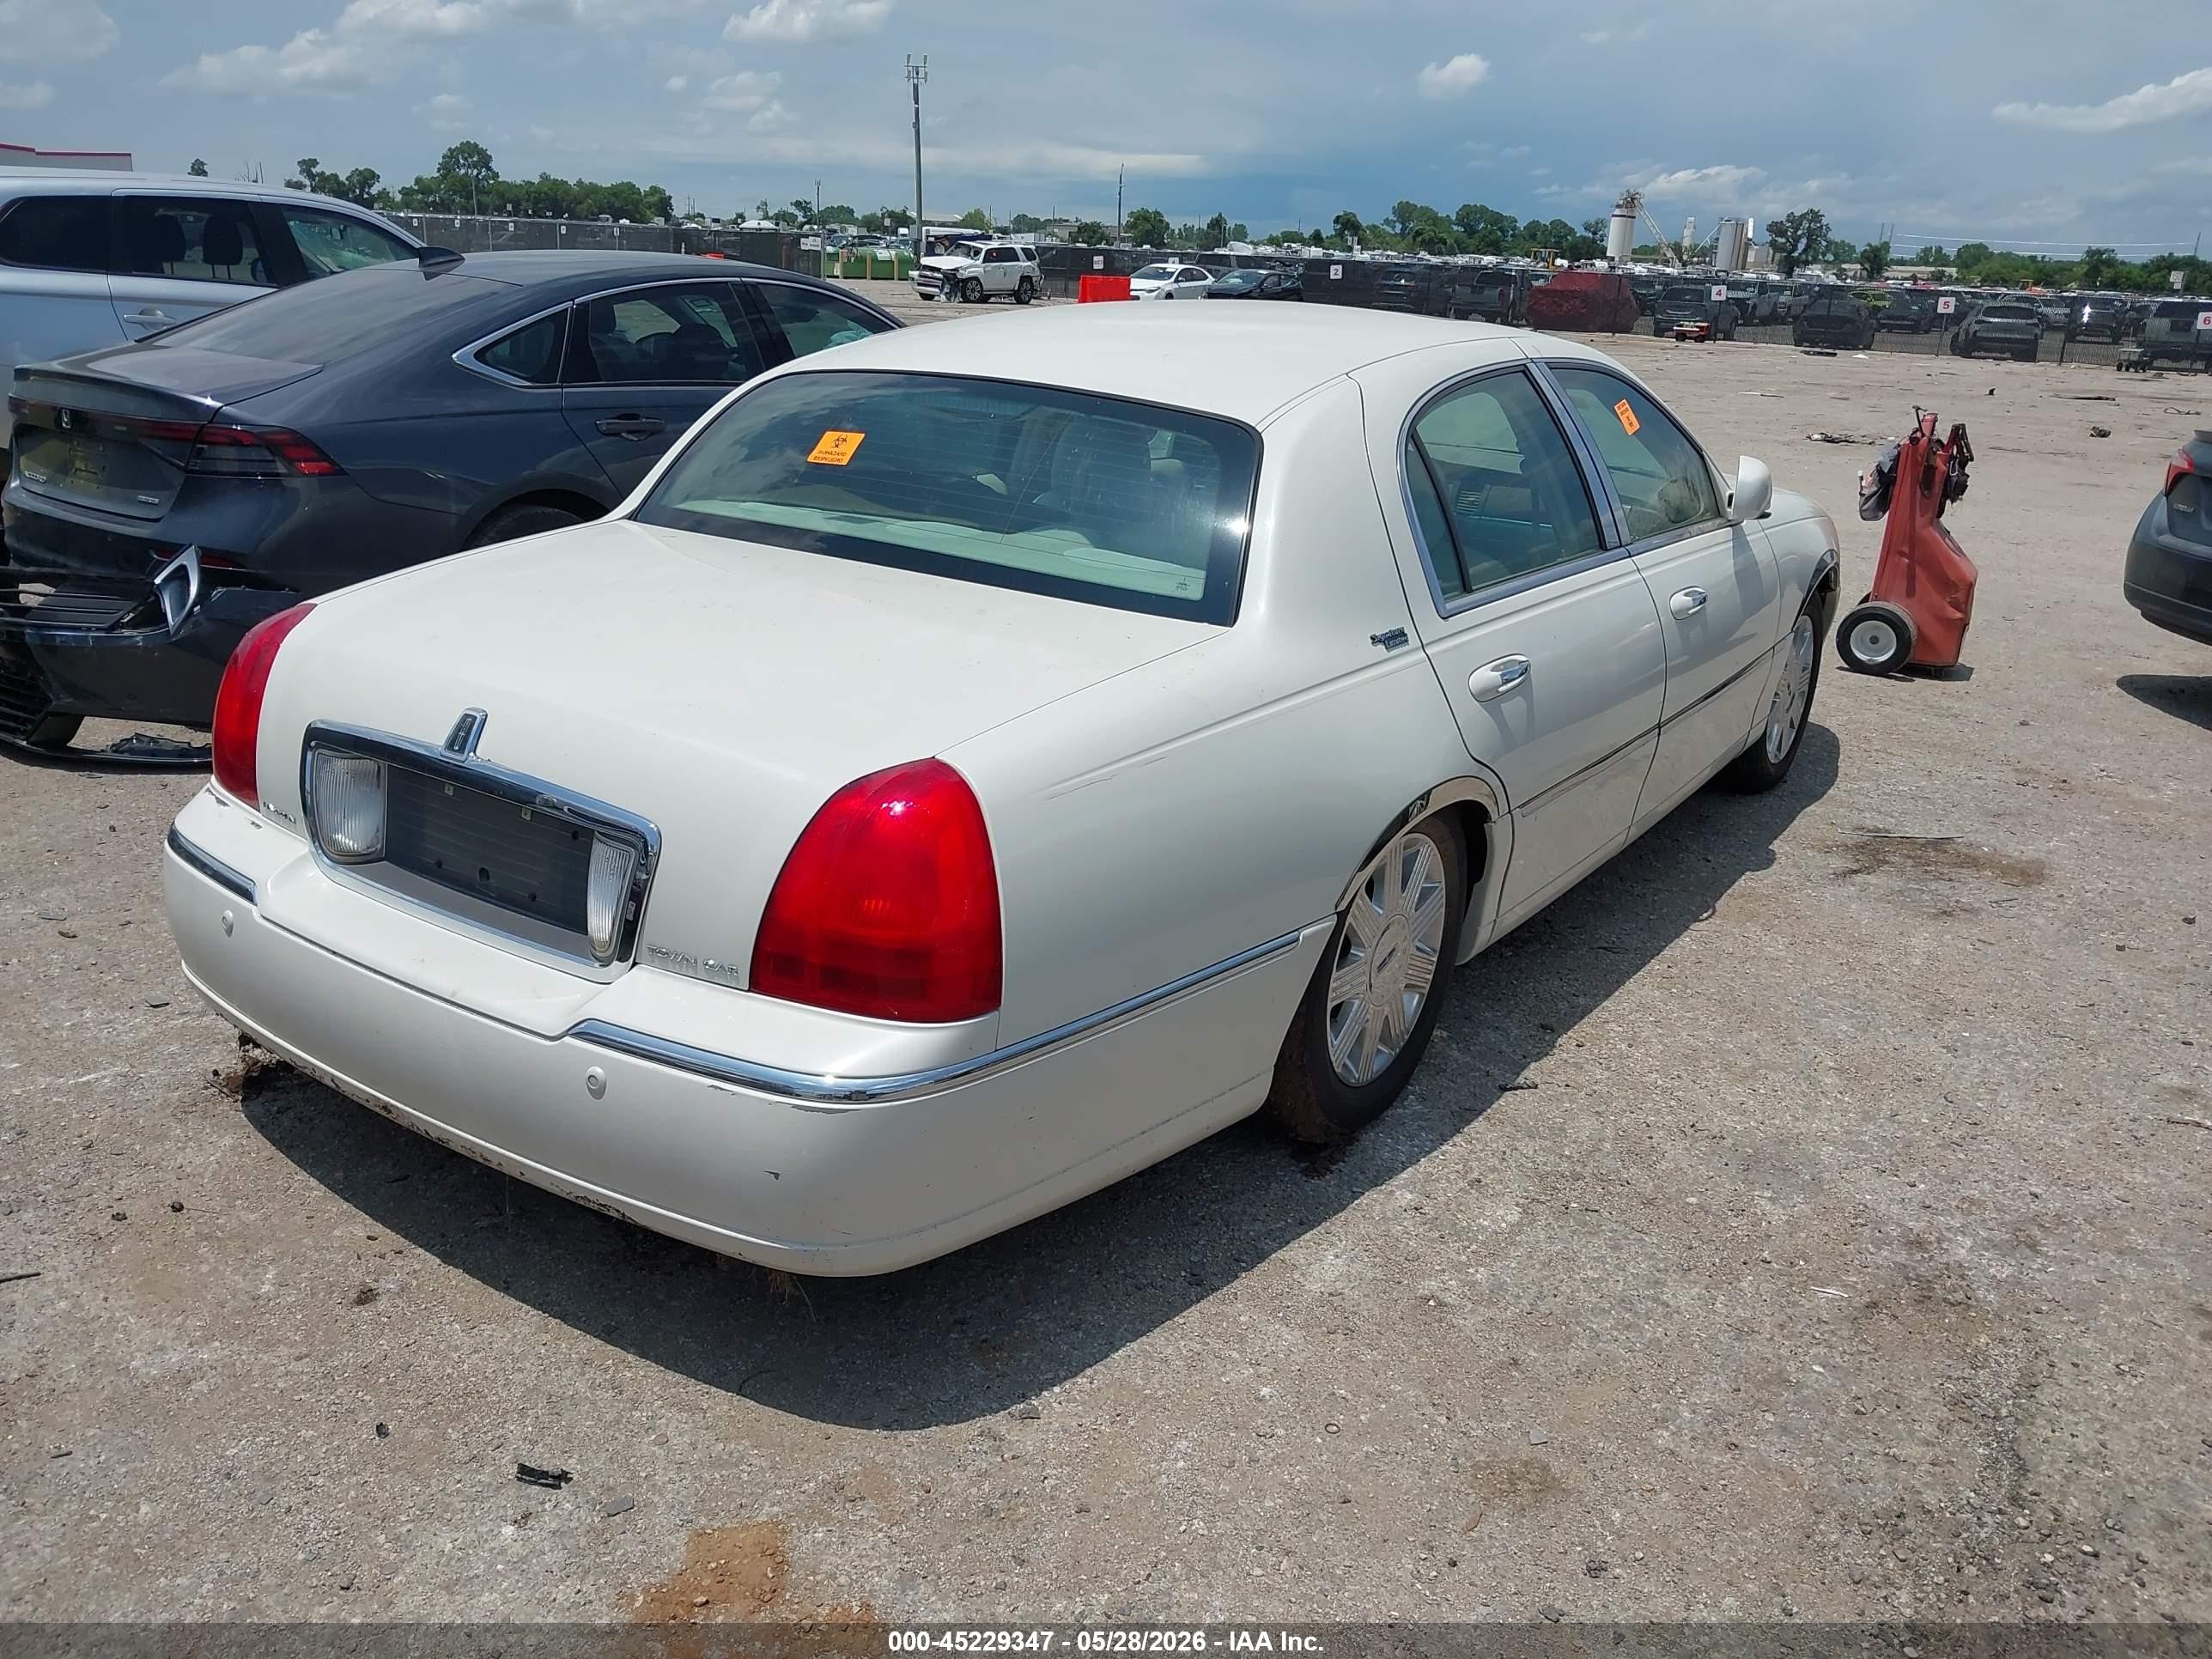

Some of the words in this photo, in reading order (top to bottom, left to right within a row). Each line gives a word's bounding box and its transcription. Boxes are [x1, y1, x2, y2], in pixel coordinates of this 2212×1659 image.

[1716, 289, 1723, 297] 4
[1942, 301, 1950, 310] 5
[2203, 316, 2211, 325] 6
[646, 944, 698, 966] TOWN
[702, 957, 739, 976] CAR
